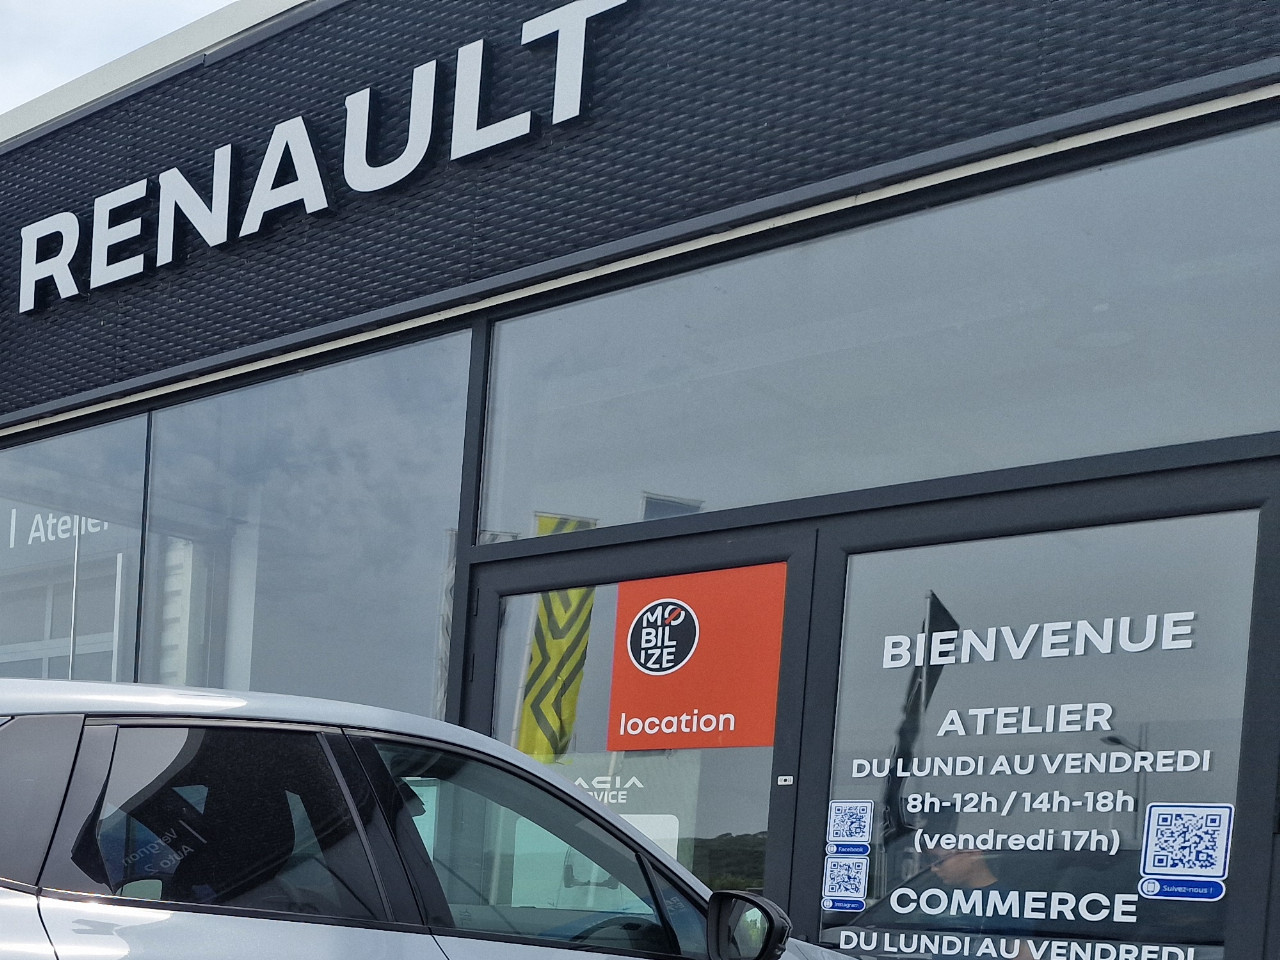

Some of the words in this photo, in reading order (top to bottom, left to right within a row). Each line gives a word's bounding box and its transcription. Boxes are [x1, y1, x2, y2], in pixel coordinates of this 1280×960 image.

[20, 0, 624, 314] RENAULT
[882, 611, 1195, 669] BIENVENUE
[619, 708, 735, 736] location
[936, 702, 1113, 737] ATELIER
[851, 757, 890, 778] DU
[896, 755, 984, 778] LUNDI
[989, 754, 1035, 776] AU
[1041, 750, 1211, 774] VENDREDI
[574, 775, 644, 789] ACIA
[905, 792, 998, 814] 8h-12h
[1022, 790, 1134, 813] 14h-18h
[913, 829, 1054, 853] (vendredi
[1060, 829, 1121, 855] 17h)
[889, 887, 1139, 923] COMMERCE
[839, 930, 878, 952] DU
[883, 933, 970, 957] LUNDI
[975, 937, 1020, 960] AU
